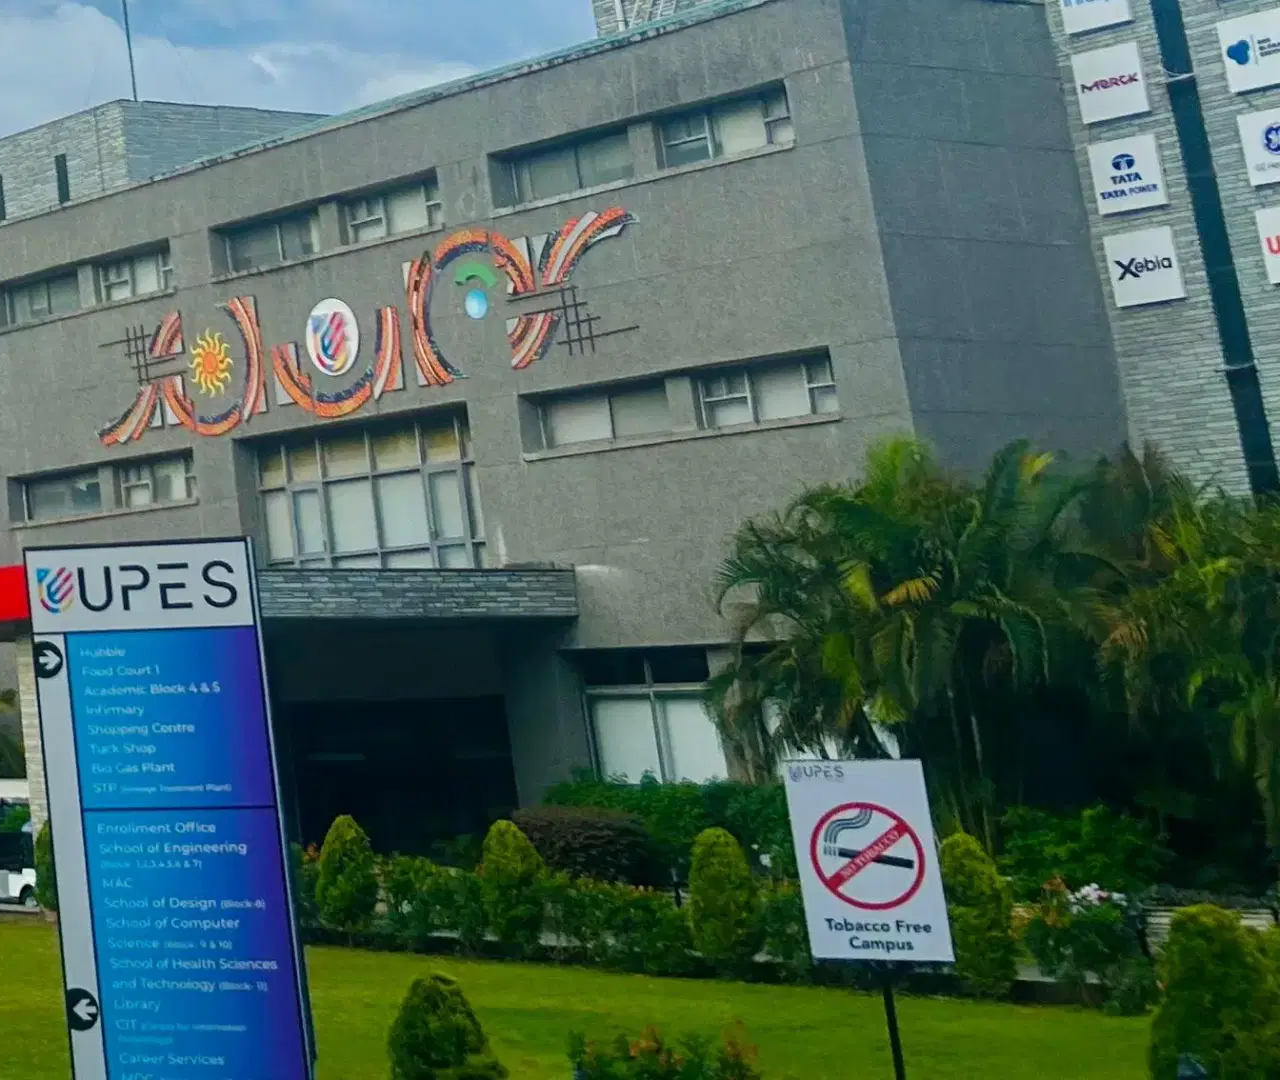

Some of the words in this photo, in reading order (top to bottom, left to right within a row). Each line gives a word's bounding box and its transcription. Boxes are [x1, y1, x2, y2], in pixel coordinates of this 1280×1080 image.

[1110, 172, 1142, 186] TATA
[1100, 188, 1128, 200] TATA
[1128, 183, 1158, 196] POWER
[1114, 256, 1173, 281] Xebia
[77, 560, 237, 612] UPES
[80, 646, 126, 658] Hubble
[82, 666, 113, 677] Food
[117, 665, 151, 676] Court
[155, 664, 160, 675] 1
[84, 685, 147, 696] Academic
[150, 683, 186, 695] Block
[188, 681, 198, 693] 4
[200, 682, 210, 693] &
[86, 704, 144, 718] Infirmary
[87, 723, 149, 737] Shopping
[152, 722, 196, 734] Centre
[89, 743, 120, 755] Tuck
[123, 743, 157, 755] Shop
[115, 762, 140, 773] Gas
[141, 761, 176, 773] Plant
[802, 764, 845, 778] UPES
[175, 821, 217, 834] Office
[99, 841, 144, 855] School
[147, 842, 160, 854] of
[163, 841, 248, 856] Engineering
[104, 896, 149, 909] School
[152, 897, 166, 909] of
[169, 897, 217, 912] Design
[106, 916, 151, 929] School
[154, 917, 168, 929] of
[171, 917, 241, 931] Computer
[824, 918, 890, 934] Tobacco
[896, 920, 932, 934] Free
[107, 938, 160, 949] Science
[849, 936, 914, 953] Campus
[109, 957, 153, 970] School
[156, 958, 169, 970] of
[172, 957, 216, 970] Health
[219, 957, 278, 970] Sciences
[111, 977, 137, 990] and
[140, 977, 216, 993] Technology
[113, 996, 161, 1013] Library
[119, 1052, 165, 1066] Career
[167, 1051, 225, 1067] Services
